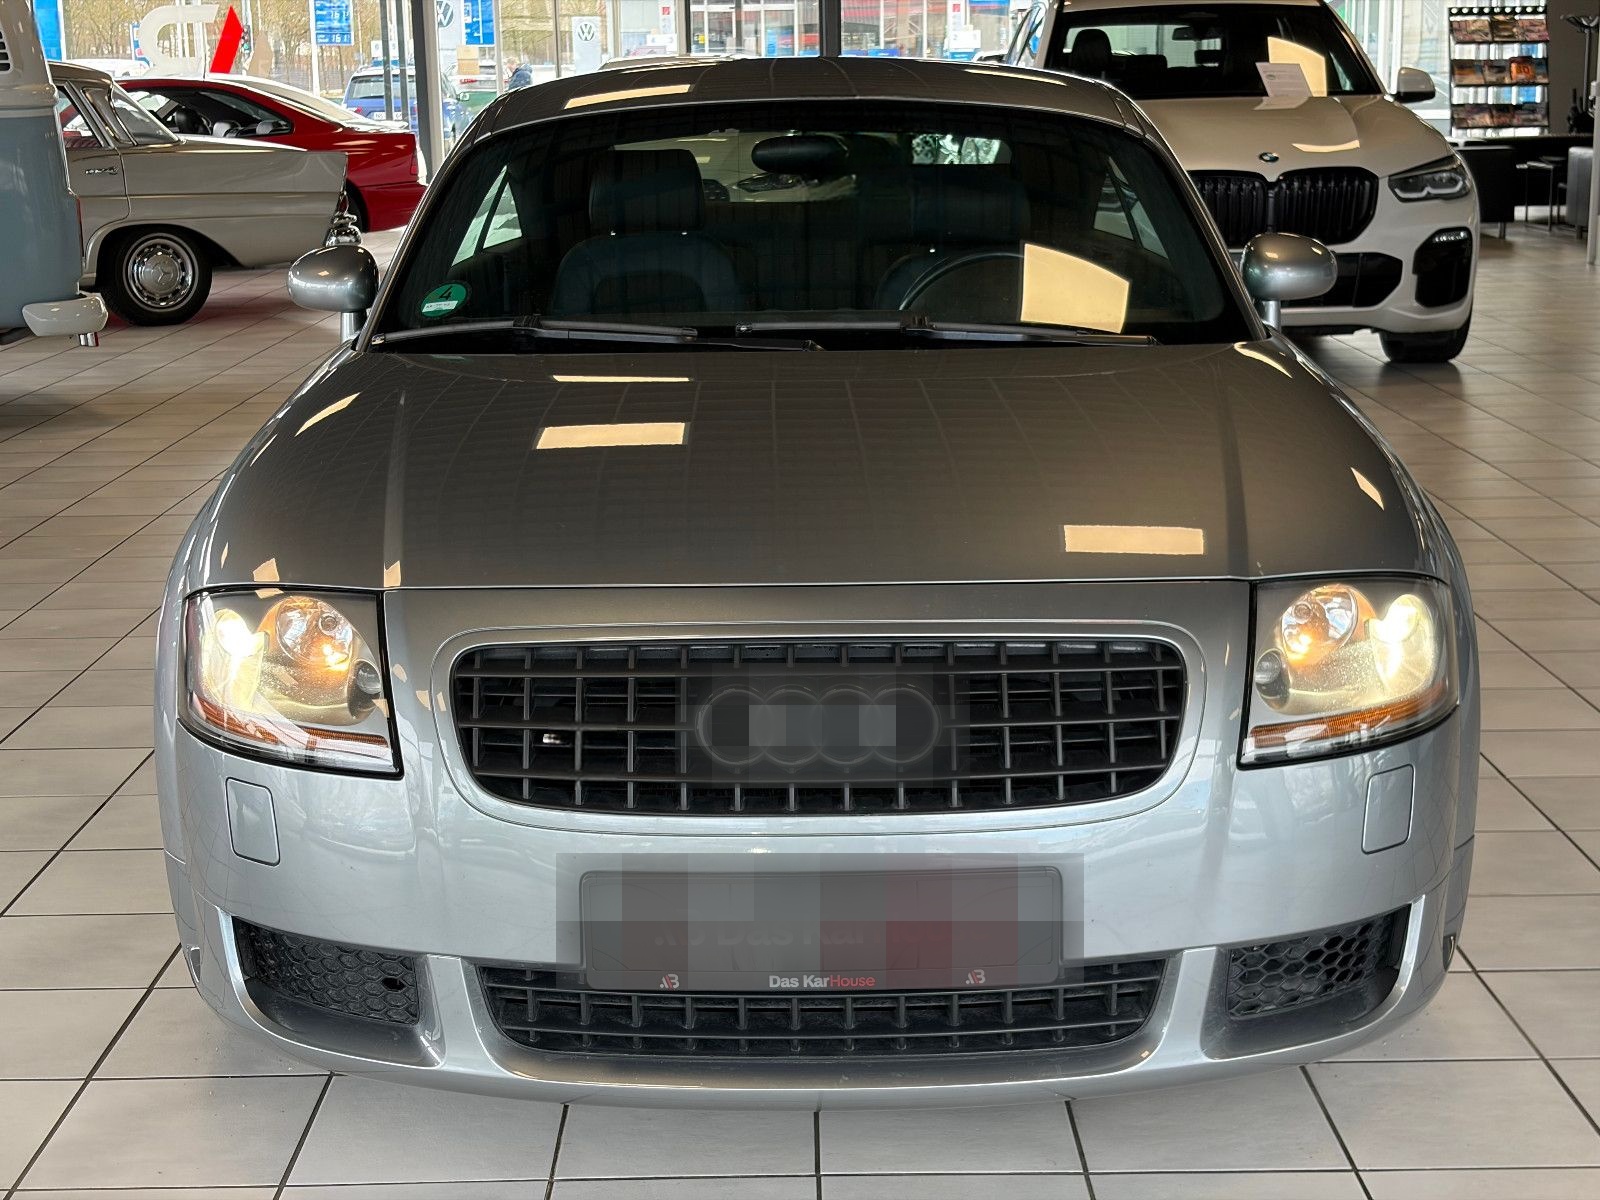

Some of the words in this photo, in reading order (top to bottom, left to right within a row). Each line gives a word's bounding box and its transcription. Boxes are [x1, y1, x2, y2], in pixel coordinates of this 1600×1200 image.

[438, 284, 452, 300] 4
[768, 975, 799, 988] Das
[803, 974, 876, 988] KarHouse
